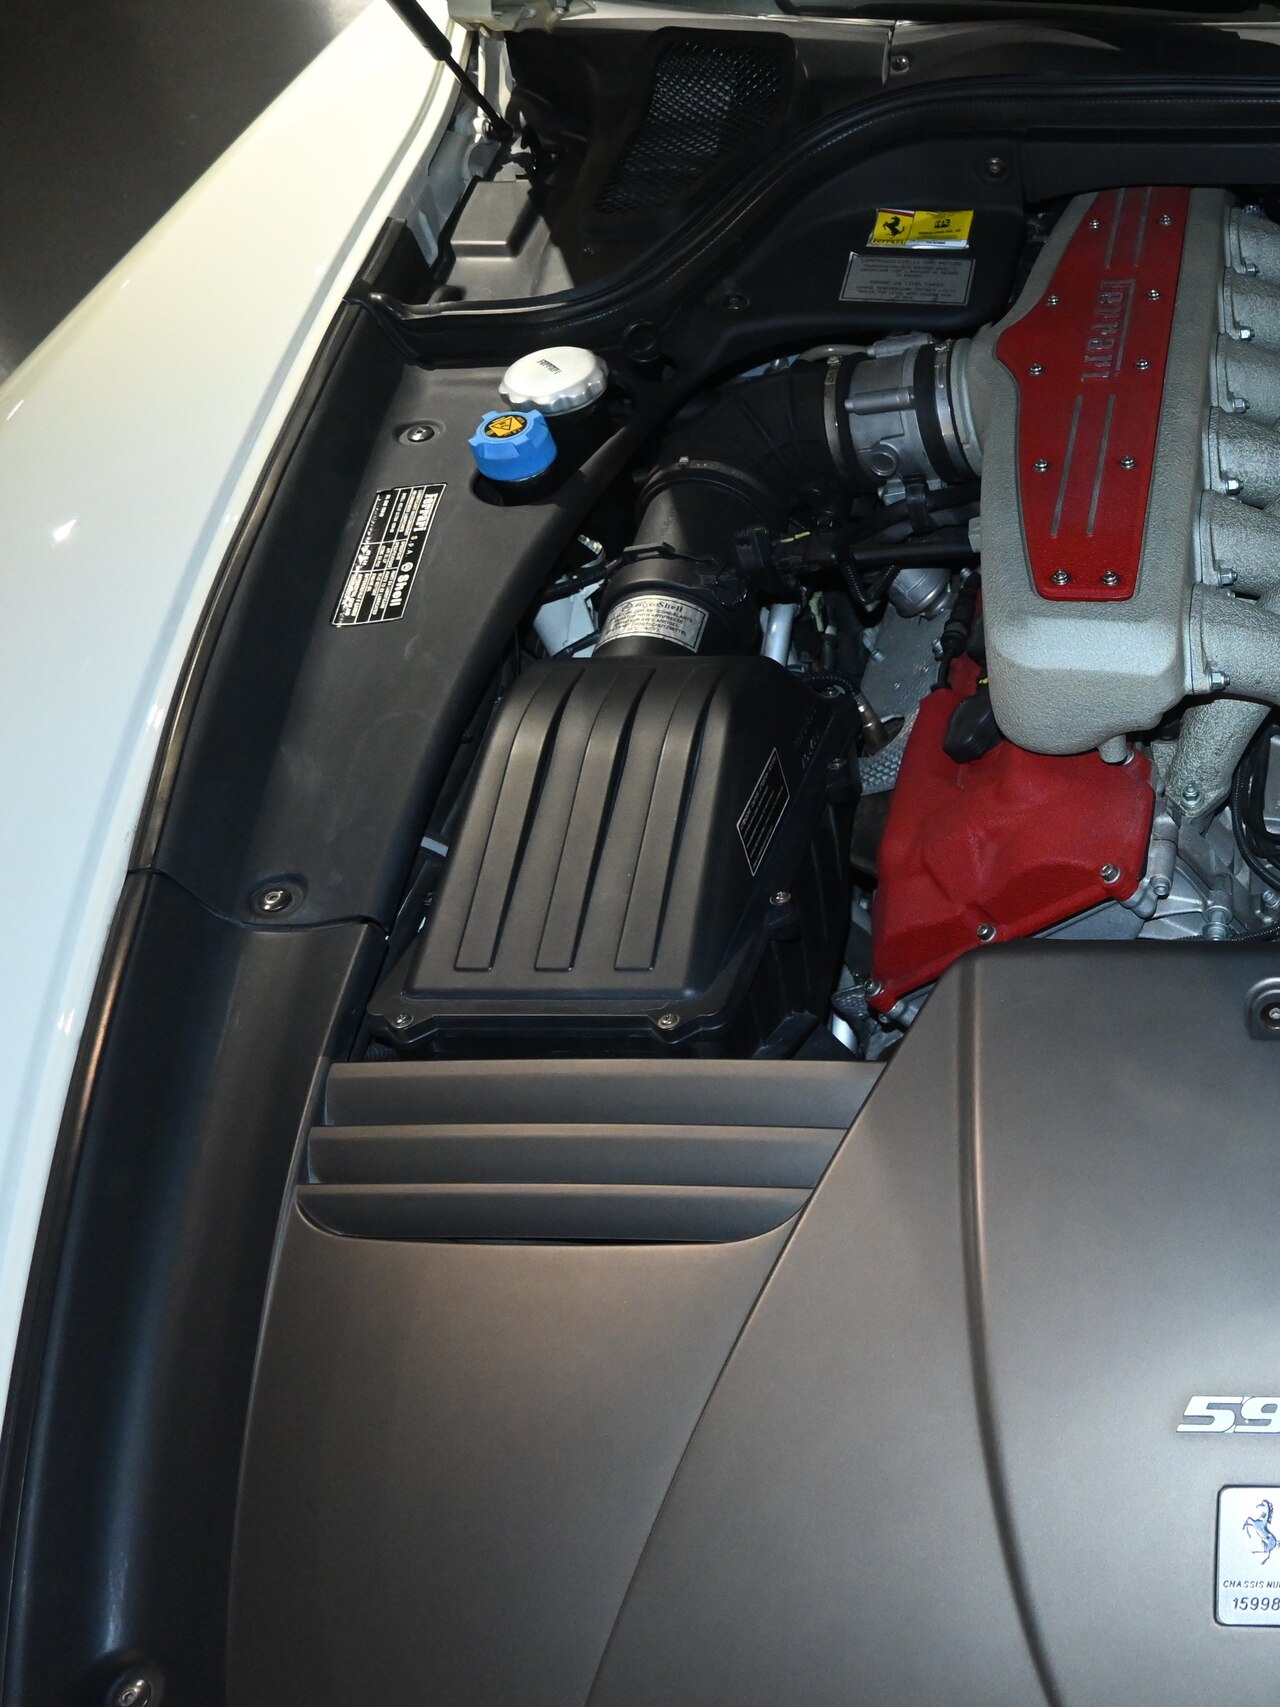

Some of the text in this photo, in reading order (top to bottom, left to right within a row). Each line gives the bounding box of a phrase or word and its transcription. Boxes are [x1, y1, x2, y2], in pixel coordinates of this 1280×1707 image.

[1080, 279, 1135, 384] Ferrari
[537, 359, 562, 374] Ferrari
[412, 492, 438, 532] Ferrari
[388, 573, 410, 606] Shell
[1223, 1579, 1265, 1589] CHASSIS
